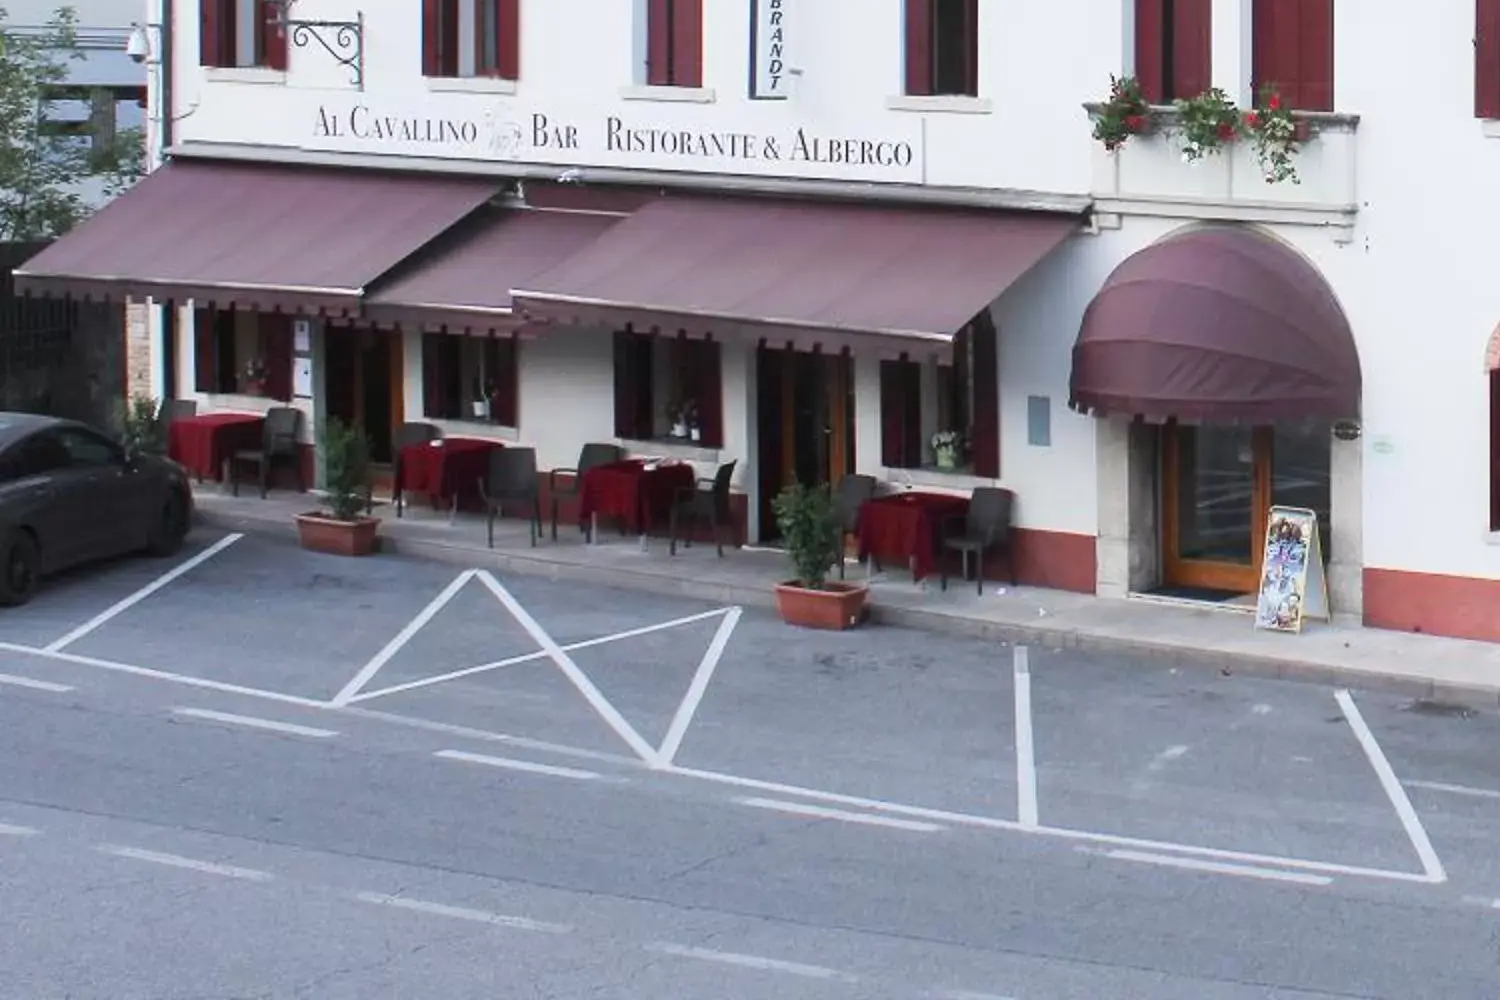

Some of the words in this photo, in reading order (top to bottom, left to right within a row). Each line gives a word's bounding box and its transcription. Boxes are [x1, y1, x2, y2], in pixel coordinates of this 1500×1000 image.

[350, 104, 478, 144] CAVALLINO
[531, 112, 580, 149] BAR
[606, 116, 757, 160] RISTORANTE
[762, 135, 781, 161] &
[790, 126, 913, 167] ALBERGO
